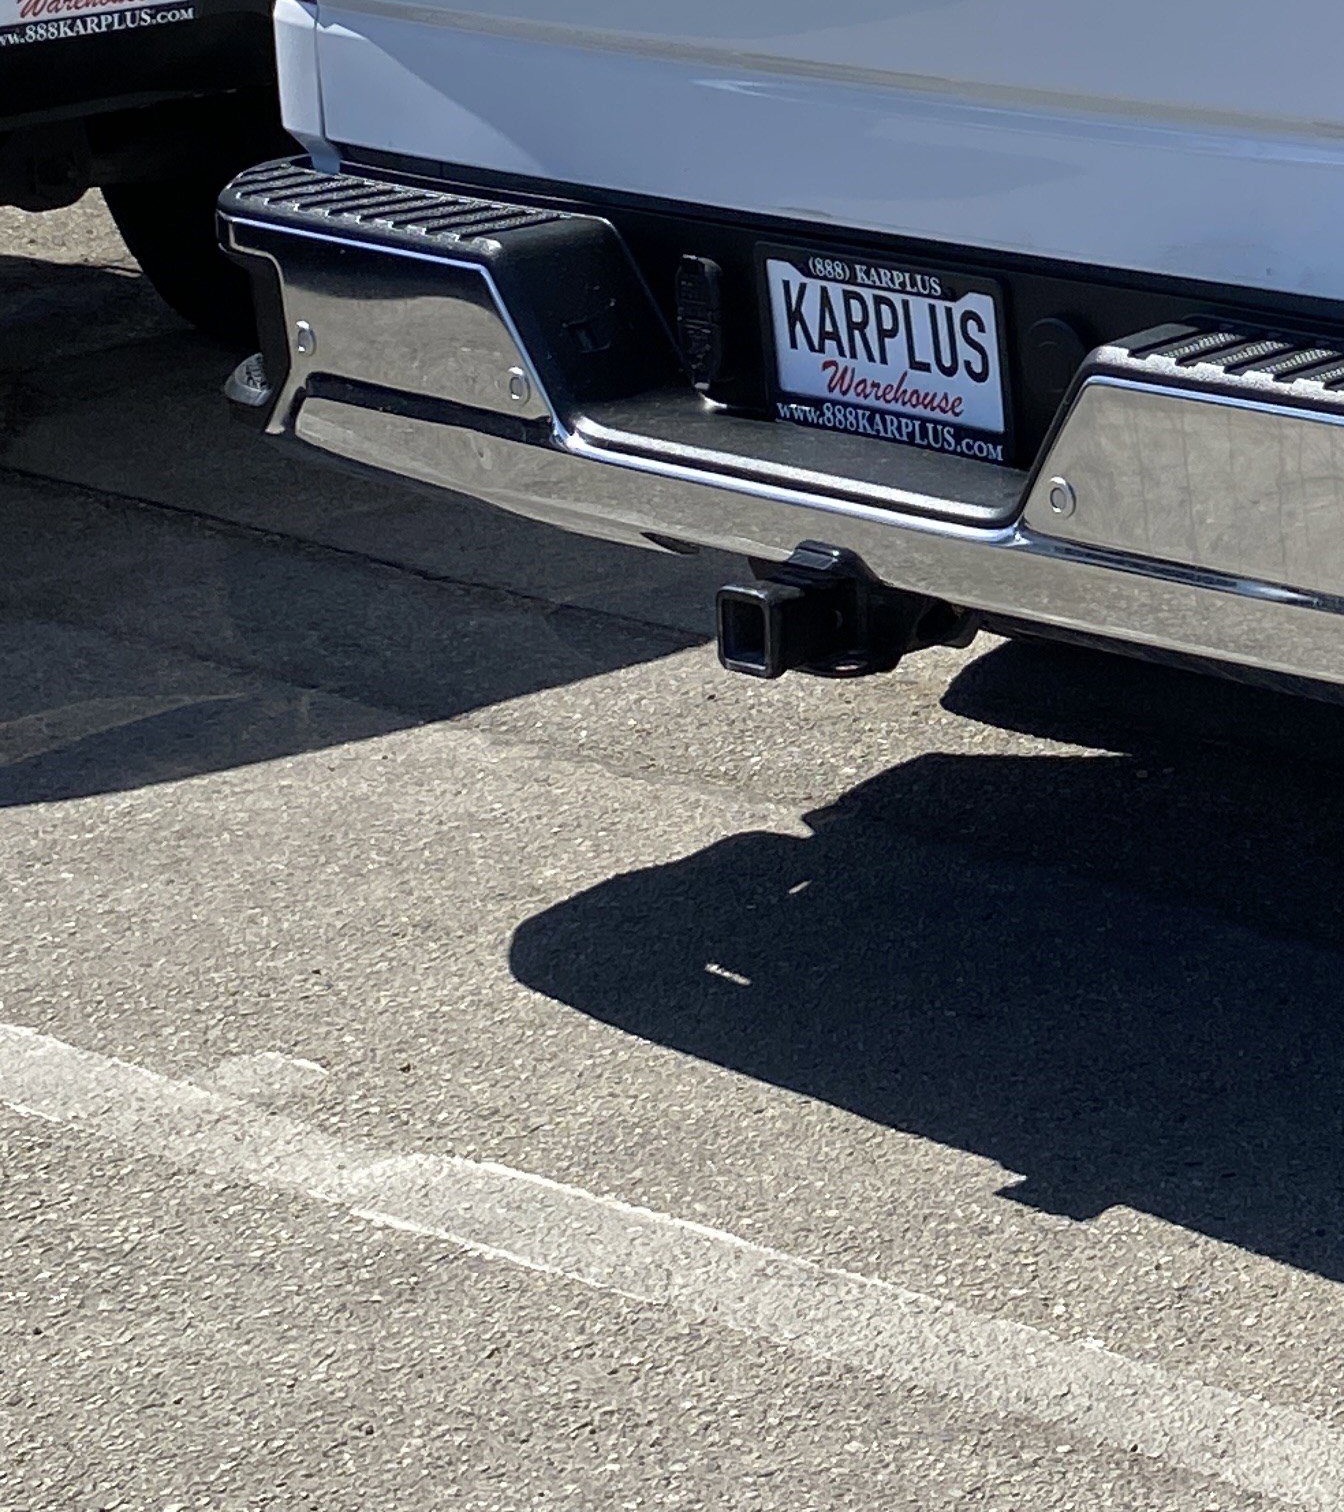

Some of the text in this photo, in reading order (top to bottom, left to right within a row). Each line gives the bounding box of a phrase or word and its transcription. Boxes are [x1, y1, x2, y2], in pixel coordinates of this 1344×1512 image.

[809, 257, 942, 296] (888) KARPLUS
[782, 280, 989, 384] KARPLUS
[821, 360, 964, 417] Warehouse
